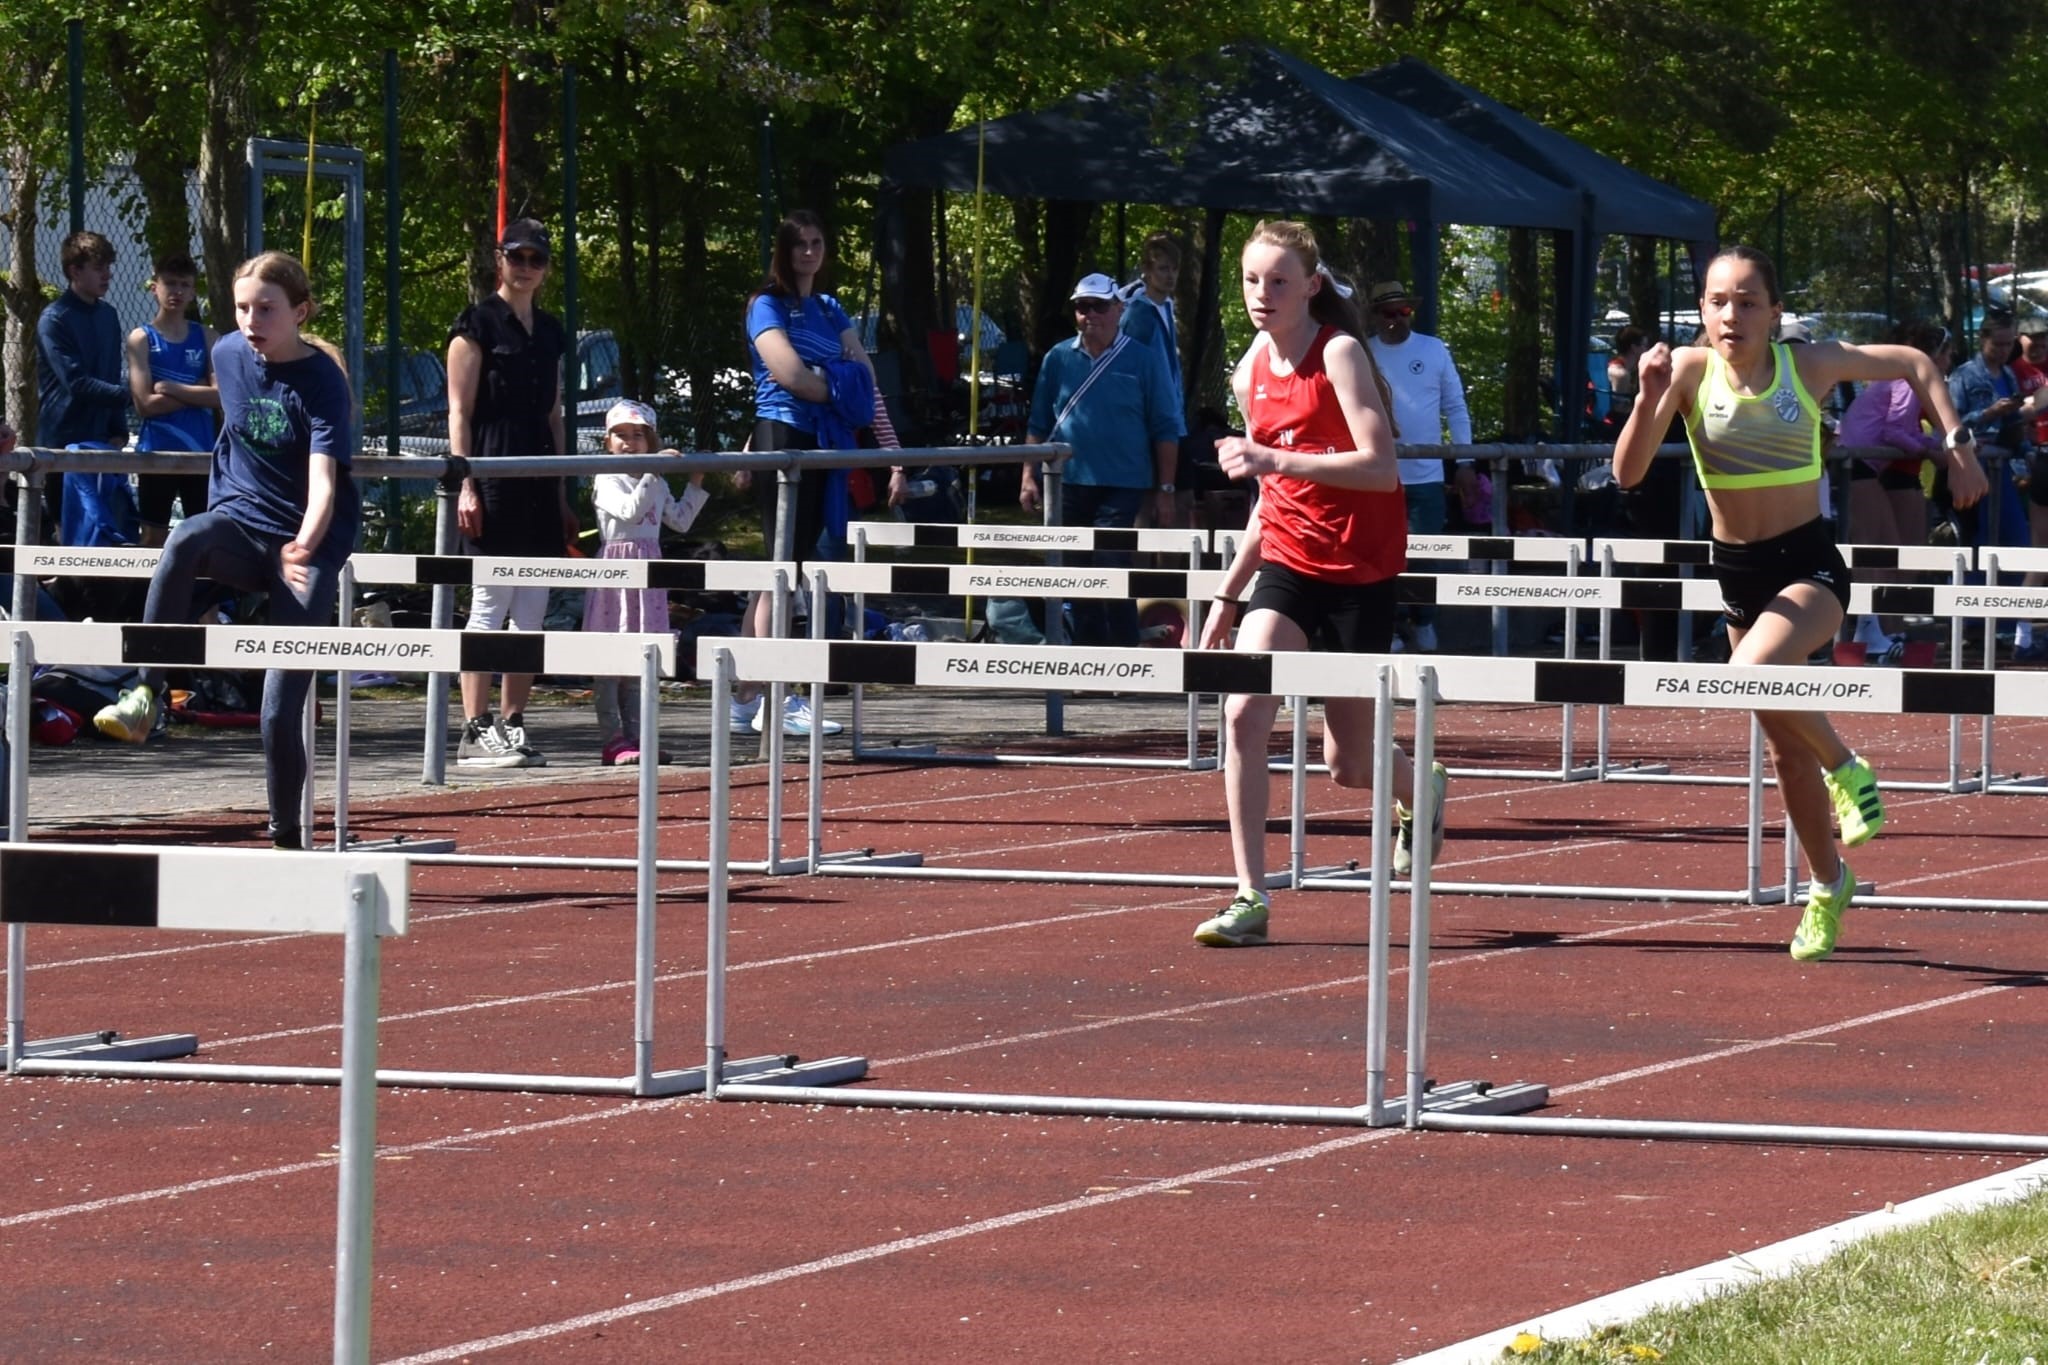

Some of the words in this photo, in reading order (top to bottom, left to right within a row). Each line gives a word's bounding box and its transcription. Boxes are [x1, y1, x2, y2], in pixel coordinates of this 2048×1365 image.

[973, 532, 991, 542] FSA
[992, 533, 1080, 544] ESCHENBACH/OPF.
[1406, 543, 1454, 552] ACH/OPF.
[33, 556, 55, 566] FSA
[58, 556, 158, 569] ESCHENBACH/OP
[491, 566, 514, 577] FSA
[517, 567, 630, 580] ESCHENBACH/OPF.
[969, 576, 992, 587] FSA
[995, 576, 1111, 590] ESCHENBACH/OPF.
[1457, 585, 1480, 596] FSA
[1484, 586, 1603, 600] ESCHENBACH/OPF.
[1955, 596, 1979, 607] FSA
[234, 639, 266, 655] FSA
[271, 640, 435, 659] ESCHENBACH/OPF.
[945, 658, 979, 673] FSA
[985, 659, 1156, 679] ESCHENBACH/OPF.
[1655, 677, 1690, 693] FSA
[1696, 678, 1874, 699] ESCHENBACH/OPF.
